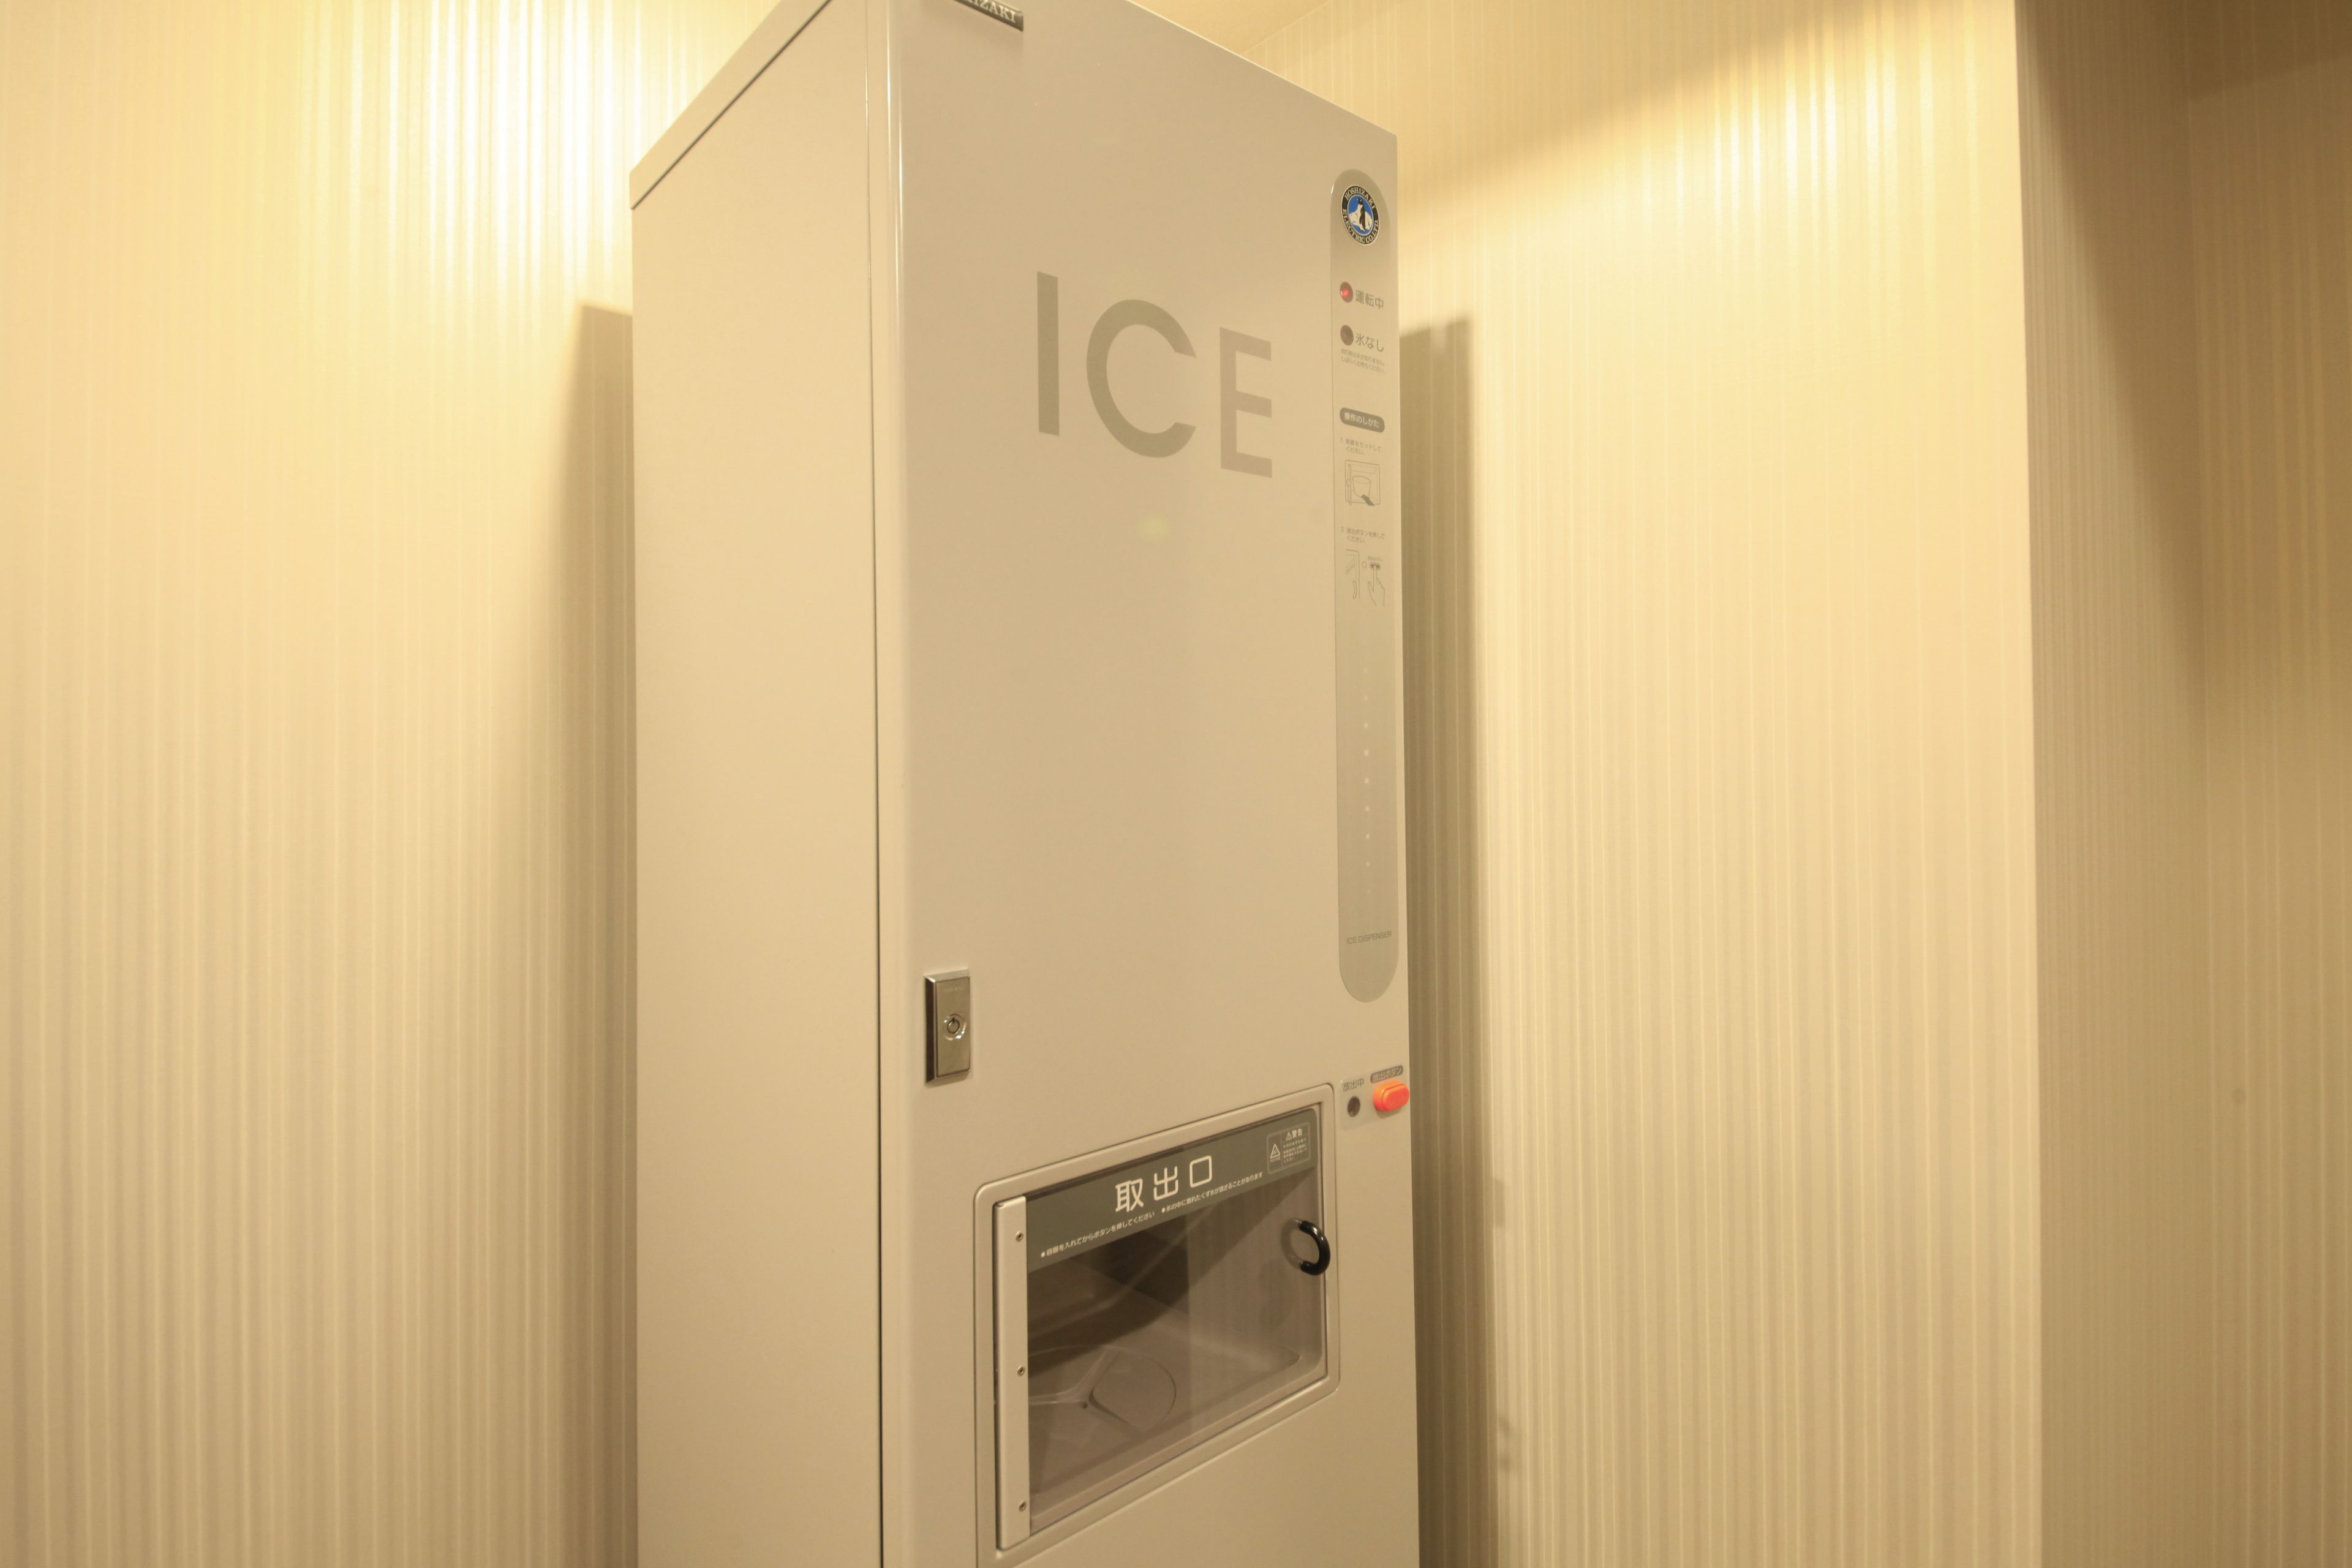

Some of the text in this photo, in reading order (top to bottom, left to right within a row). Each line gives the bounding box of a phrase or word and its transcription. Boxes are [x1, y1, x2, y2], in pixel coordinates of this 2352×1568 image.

[1344, 186, 1376, 209] HOSHIZAKI
[1343, 209, 1365, 243] ELECTRIC
[1355, 290, 1384, 309] 運転中
[1355, 333, 1384, 352] 氷なし
[1037, 271, 1272, 478] ICE
[1344, 412, 1379, 428] 操作のしかた
[1358, 930, 1392, 943] DISPENSER
[1343, 1078, 1365, 1092] 放出中
[1115, 1155, 1212, 1213] 取出口
